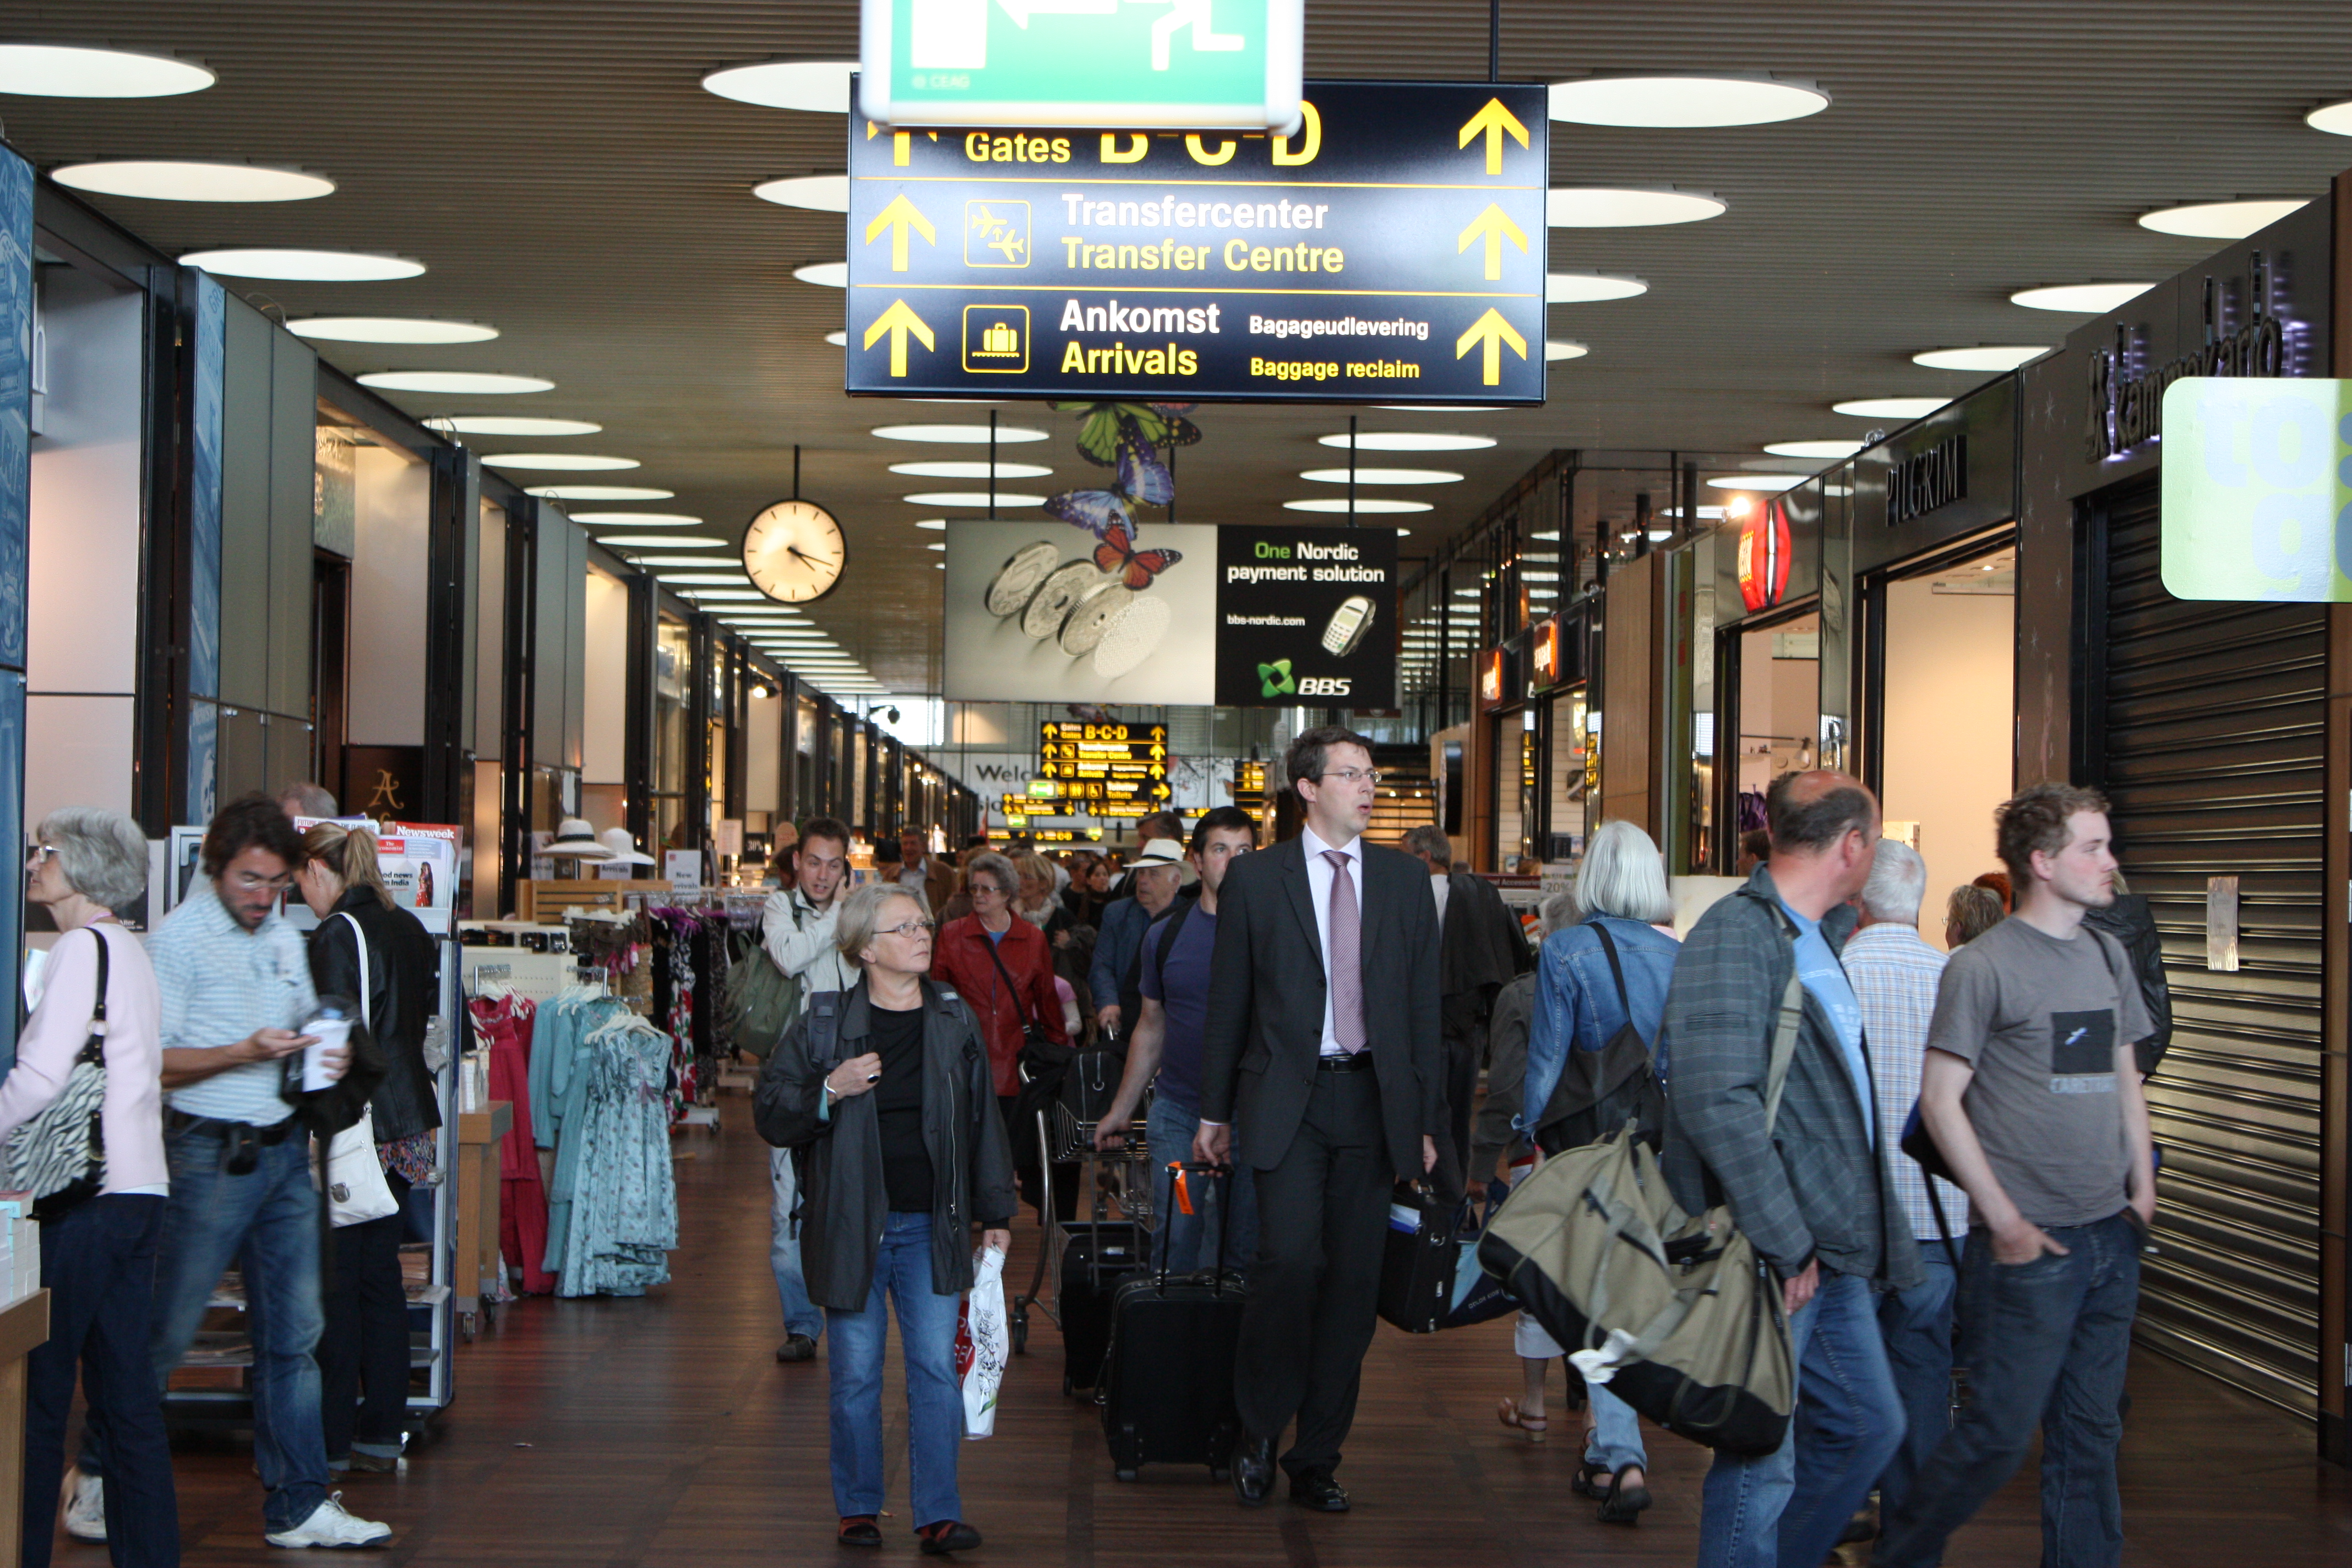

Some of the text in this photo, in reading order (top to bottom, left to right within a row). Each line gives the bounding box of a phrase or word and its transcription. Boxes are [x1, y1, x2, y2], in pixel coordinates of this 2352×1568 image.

[965, 132, 1070, 163] Gates
[1061, 194, 1329, 229] Transfercenter
[1061, 237, 1344, 273] Transfer Centre
[1060, 299, 1429, 340] Ankomst Bagageudlevering
[1061, 341, 1420, 381] Arrivals Baggage reclaim
[1886, 434, 1960, 527] PILGRIM
[1255, 542, 1359, 560] One Nordic
[1227, 565, 1385, 584] payment solution
[1227, 613, 1305, 626] bbs-nordic.com
[1298, 677, 1352, 696] BBS
[1060, 723, 1128, 740] Gates B-C-D
[396, 825, 455, 839] Newsweek
[601, 865, 629, 874] Arrivals
